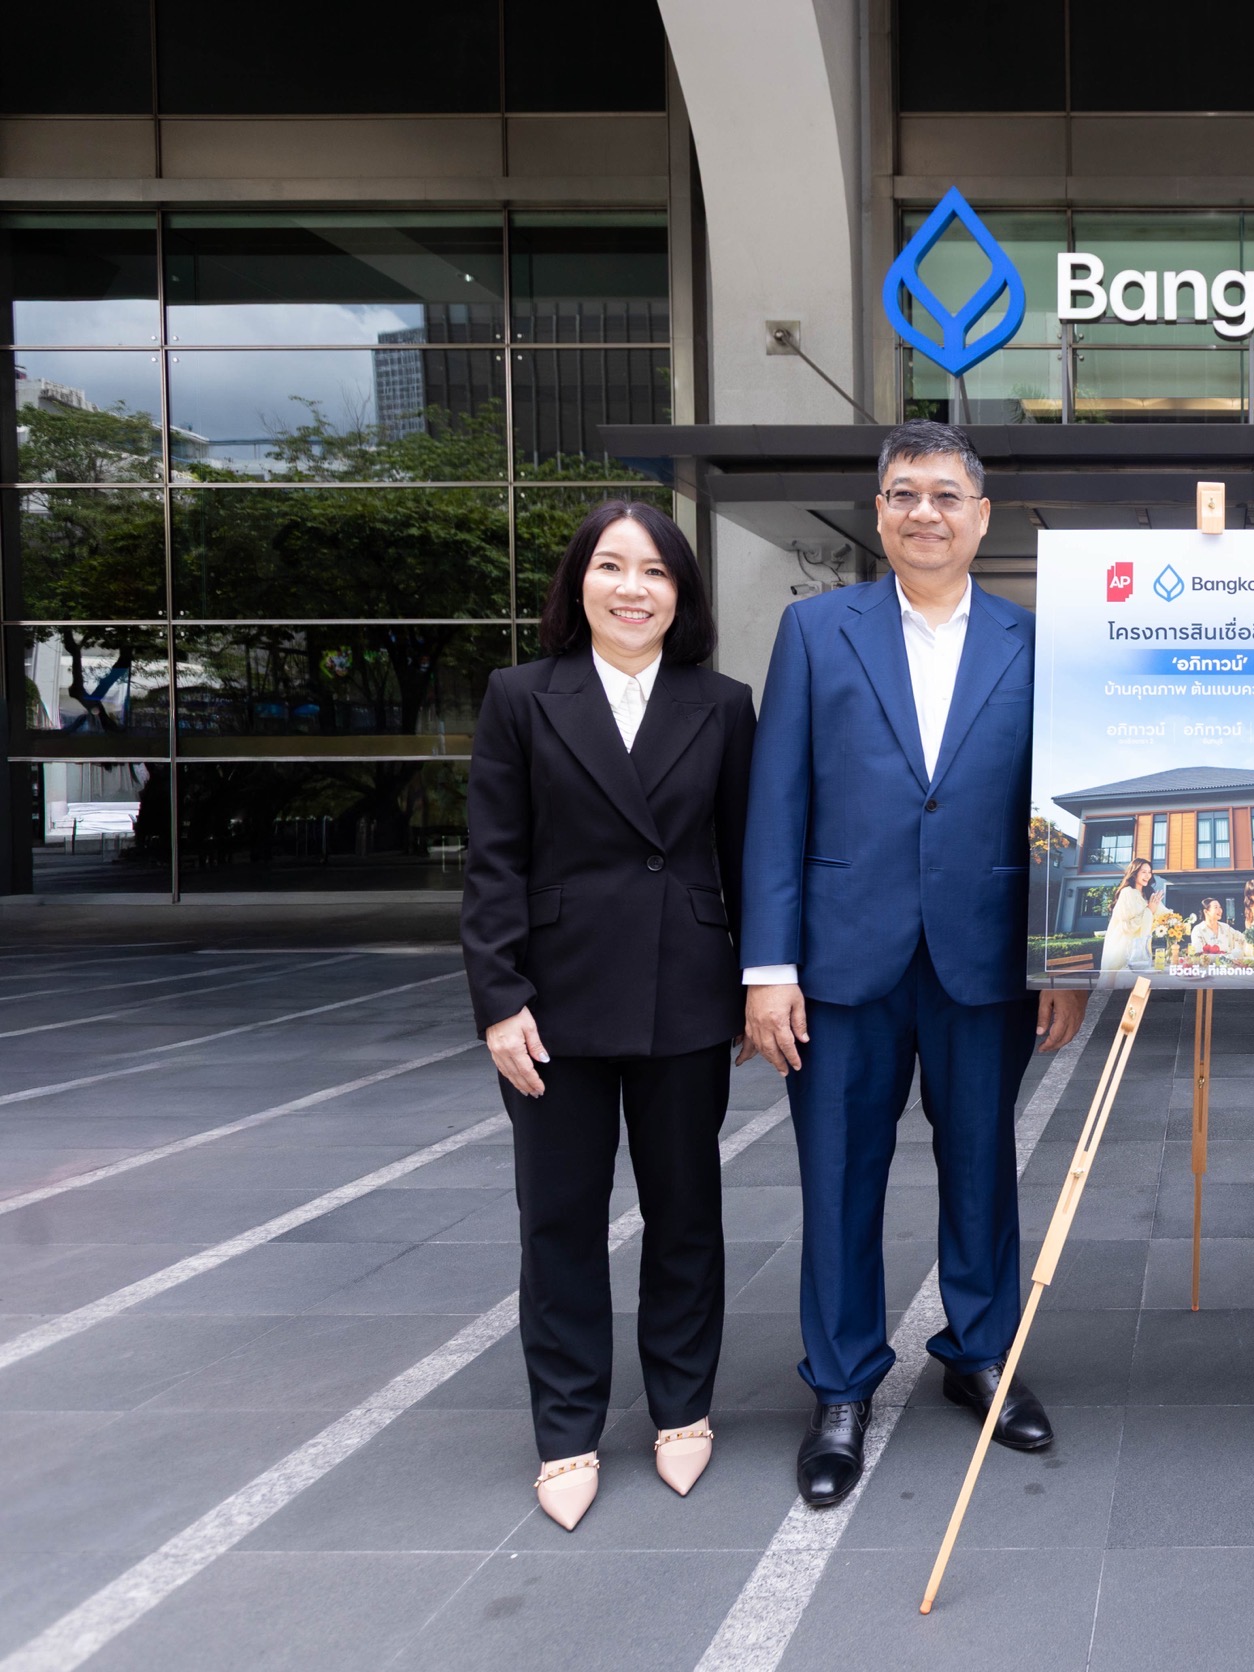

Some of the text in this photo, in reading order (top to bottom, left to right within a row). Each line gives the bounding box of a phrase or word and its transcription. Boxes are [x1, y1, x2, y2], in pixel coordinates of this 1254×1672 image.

[1109, 575, 1131, 589] AP
[1104, 680, 1187, 700] บ้านคุณภาพ
[1106, 721, 1166, 737] อภิทาวน์
[1183, 721, 1242, 737] อภิทาวน์
